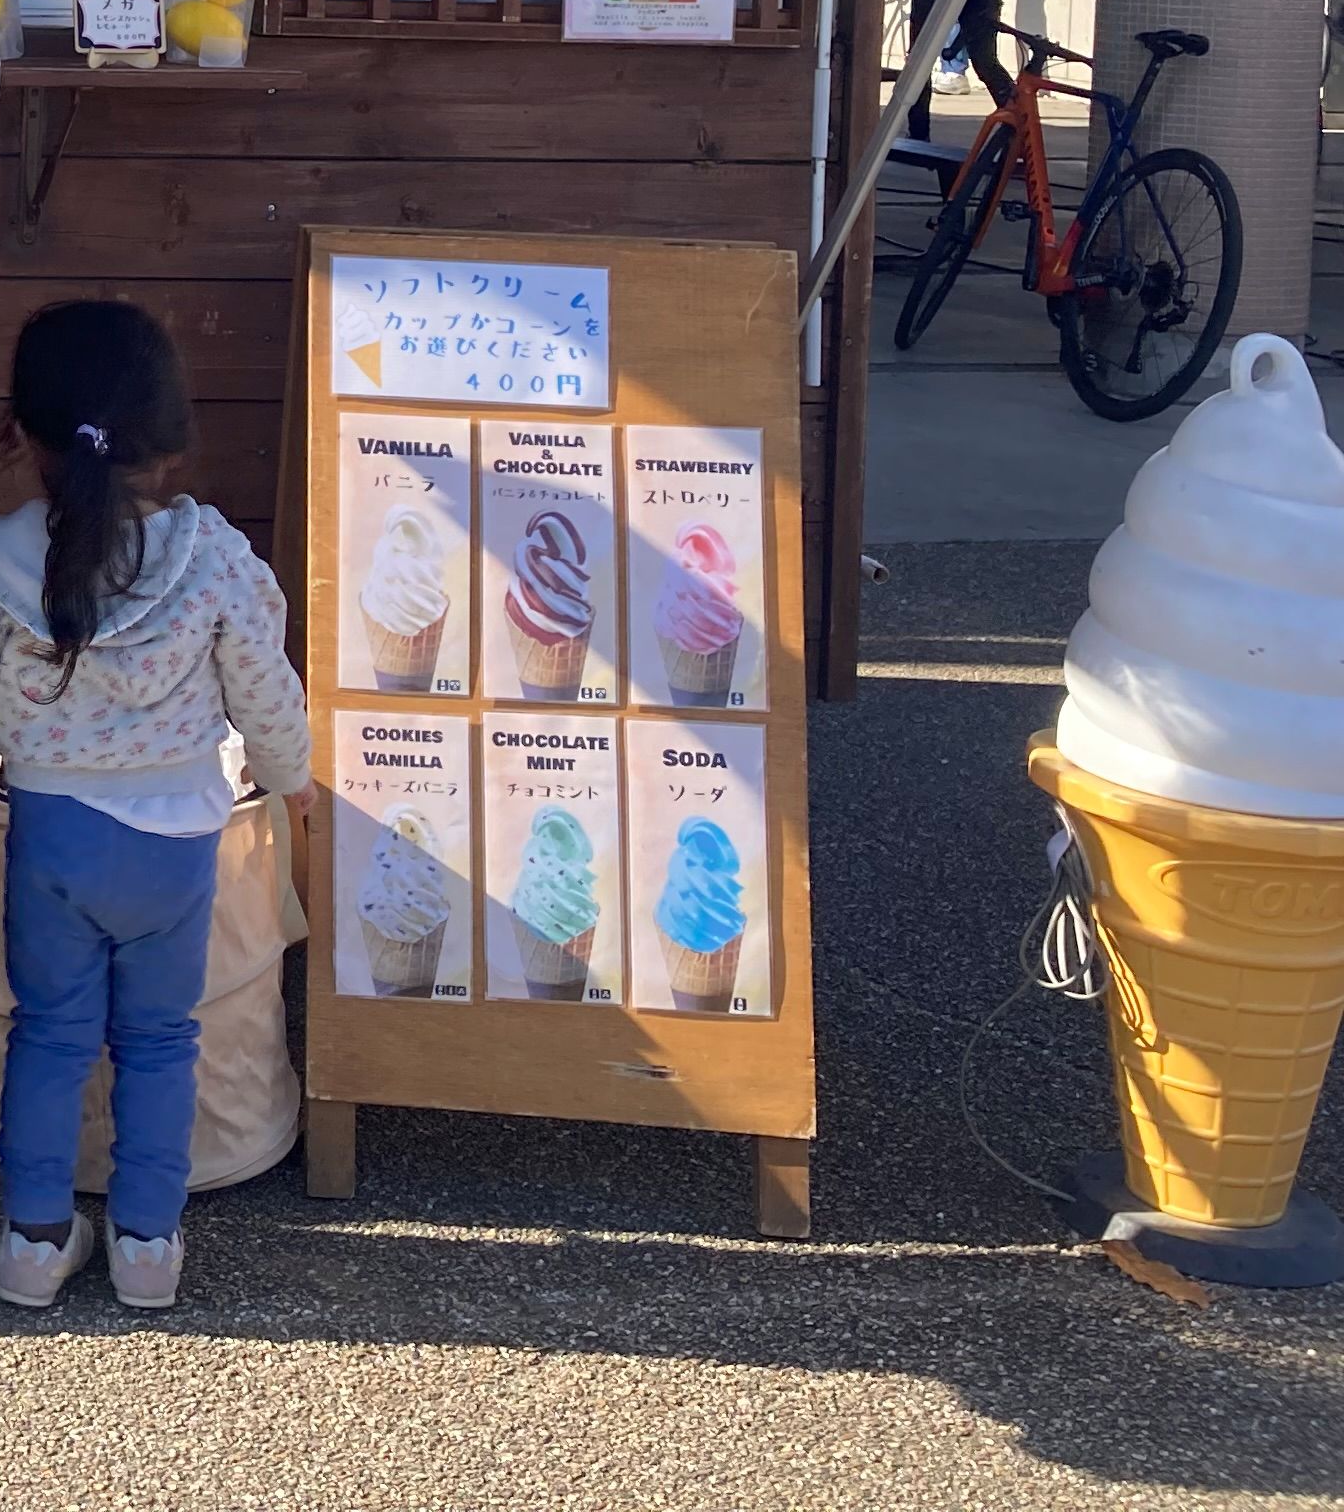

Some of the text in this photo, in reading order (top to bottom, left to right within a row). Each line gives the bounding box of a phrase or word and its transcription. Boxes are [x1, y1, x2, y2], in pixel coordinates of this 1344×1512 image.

[364, 271, 592, 313] ソフトクリーム
[385, 311, 601, 337] カップかコーンを
[399, 334, 588, 362] お選びください
[466, 372, 582, 396] 400円
[358, 437, 454, 459] VANILLA
[508, 431, 587, 449] VANILLA
[541, 448, 554, 461] &
[493, 458, 604, 477] CHOCOLATE
[635, 458, 754, 476] STRAWBERRY
[374, 474, 436, 493] バニラ
[361, 726, 444, 744] COOKIES
[492, 731, 610, 751] CHOCOLATE
[362, 751, 444, 770] VANILLA
[526, 755, 576, 771] MINT
[662, 748, 728, 769] SODA
[343, 778, 459, 797] クッキーズバニラ
[507, 783, 599, 800] チョコミント
[668, 783, 728, 804] ソーダ
